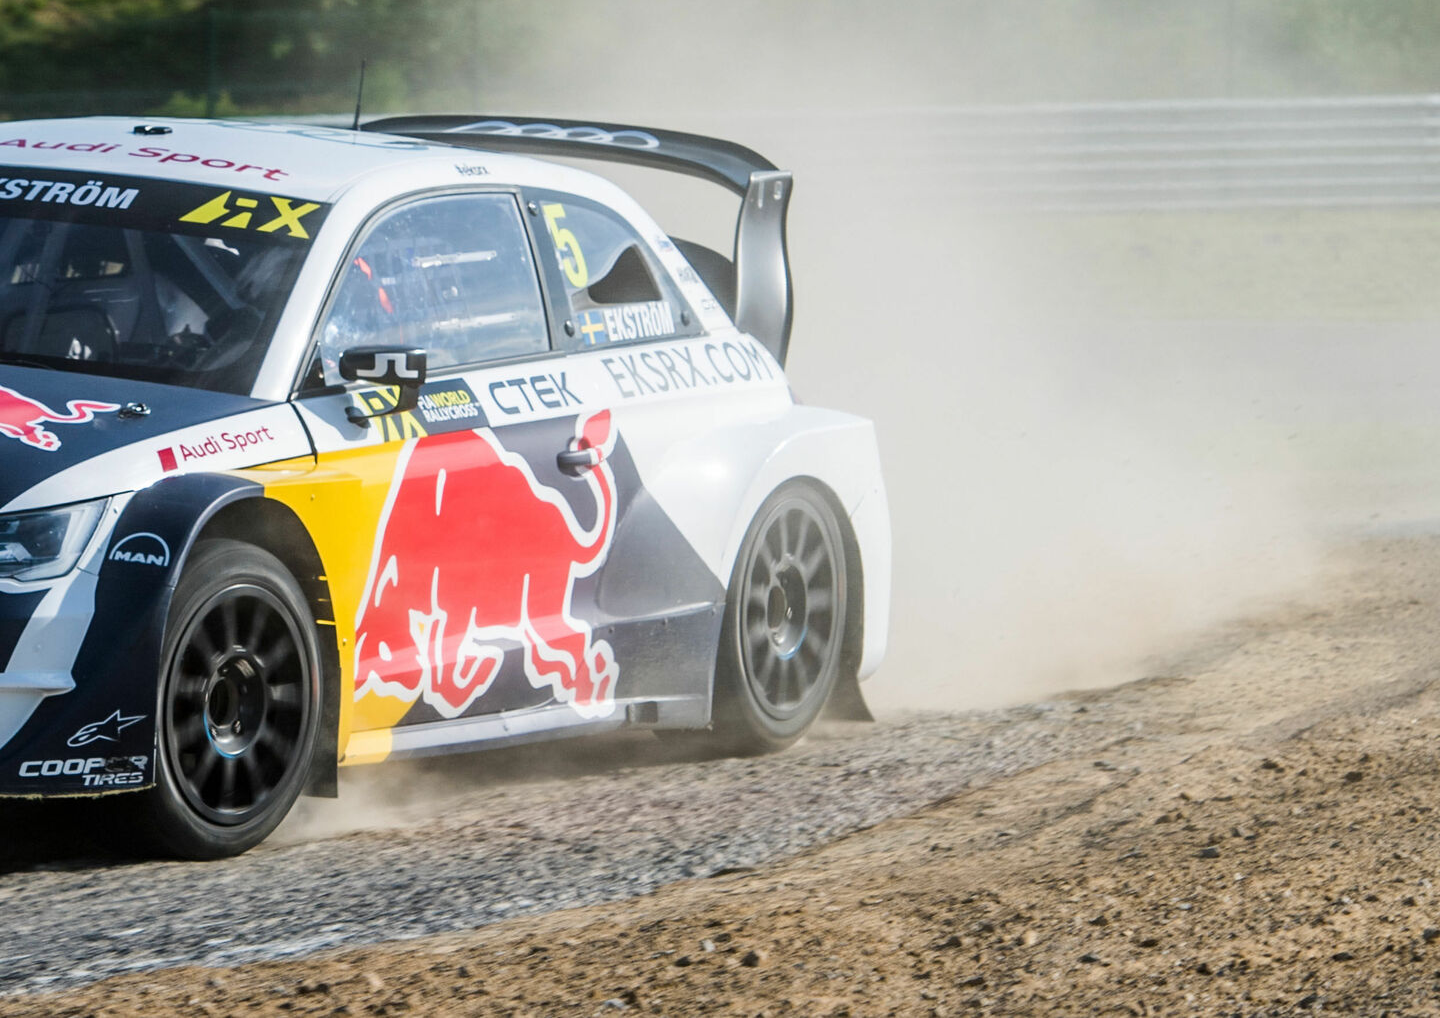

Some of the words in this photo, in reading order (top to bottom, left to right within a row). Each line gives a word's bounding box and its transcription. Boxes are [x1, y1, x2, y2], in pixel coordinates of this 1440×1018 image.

[128, 146, 290, 181] Sport
[543, 203, 588, 288] 5
[604, 301, 675, 342] EKSTRÖM
[601, 341, 773, 399] EKSRX.COM
[488, 371, 583, 415] CTEK
[422, 403, 478, 423] RALLYCROSS
[179, 435, 222, 461] Audi
[221, 426, 274, 452] Sport
[114, 550, 164, 566] MAN
[82, 772, 143, 786] TIRES
